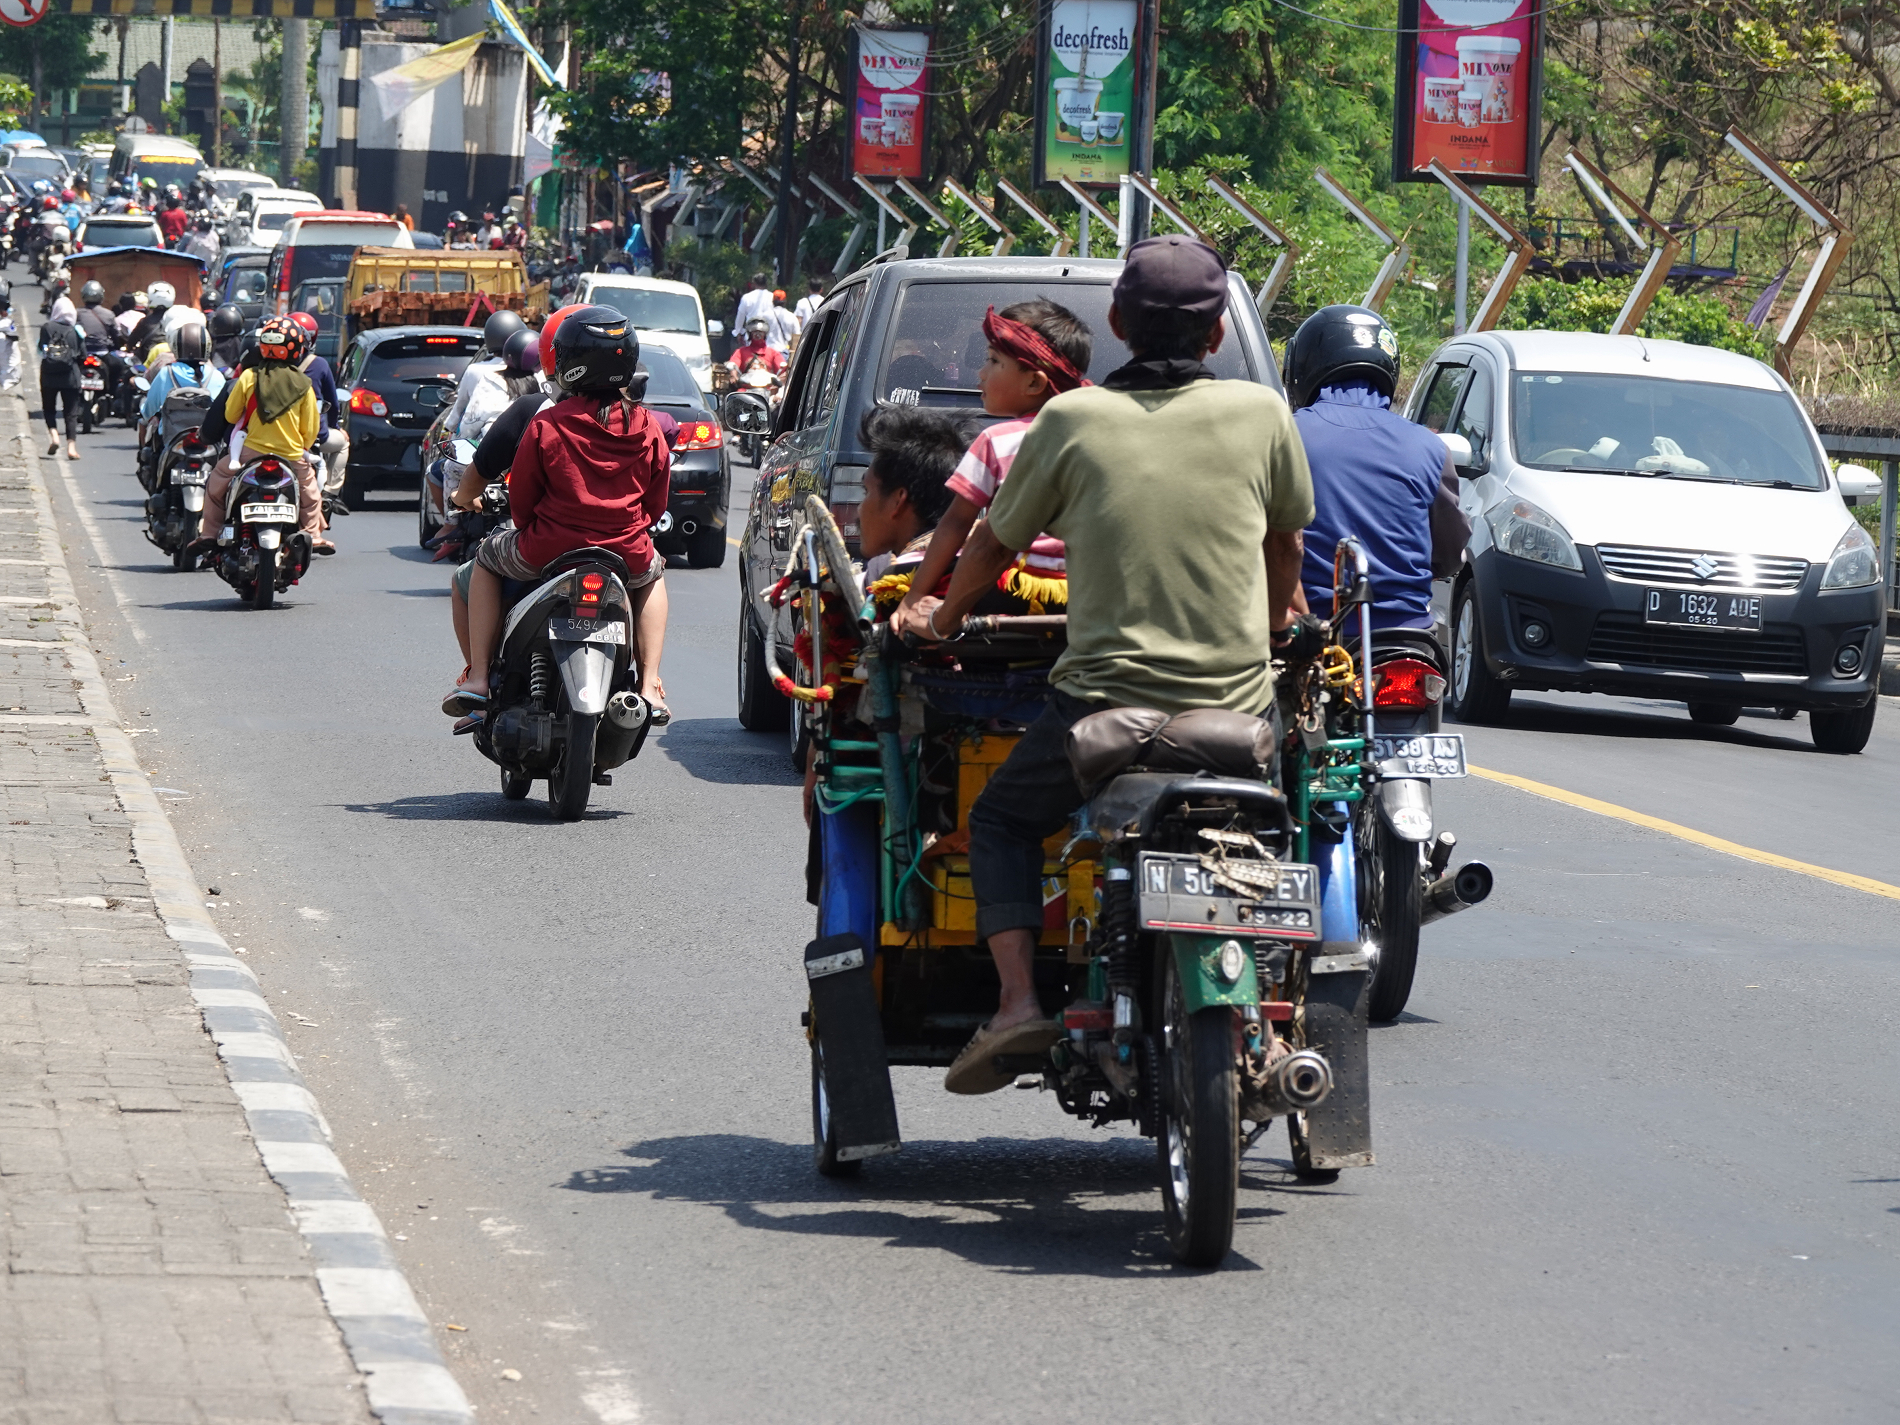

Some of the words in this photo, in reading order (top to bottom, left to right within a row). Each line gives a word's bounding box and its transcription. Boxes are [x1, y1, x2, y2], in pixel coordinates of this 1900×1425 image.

[1054, 25, 1129, 50] decofresh
[1063, 104, 1092, 114] decofresh
[1450, 135, 1489, 144] INDANA
[565, 367, 584, 380] INK
[1649, 591, 1661, 611] D
[1680, 593, 1718, 616] 1632
[1728, 598, 1760, 619] ADE
[550, 618, 558, 629] L
[567, 618, 598, 631] 5494
[607, 621, 624, 634] NX
[1374, 738, 1422, 758] 5138
[1150, 866, 1166, 893] N
